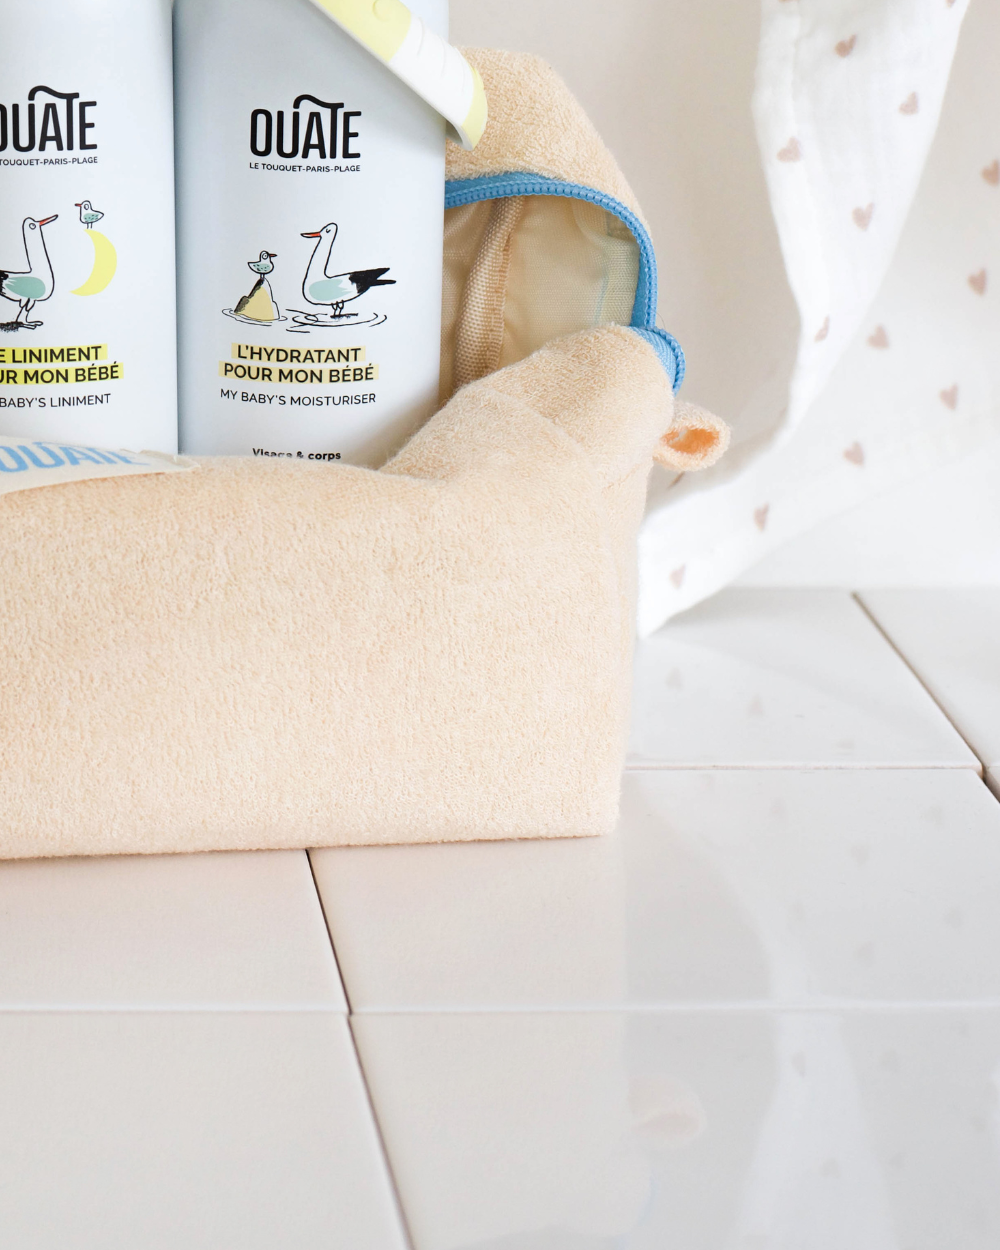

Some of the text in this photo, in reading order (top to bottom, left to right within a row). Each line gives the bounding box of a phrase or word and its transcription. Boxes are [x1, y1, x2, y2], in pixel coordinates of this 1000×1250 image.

[250, 94, 362, 159] OUATE
[249, 162, 361, 173] LE TOUQUET-PARIS-PLAGE
[12, 346, 102, 364] LINIMENT
[23, 369, 69, 384] MON
[75, 361, 119, 382] BÉBÉ
[224, 363, 374, 383] POUR MON BÉBÉ
[50, 393, 111, 408] LINIMENT
[220, 389, 376, 406] MY BABY'S MOISTURISER
[308, 452, 342, 462] corps
